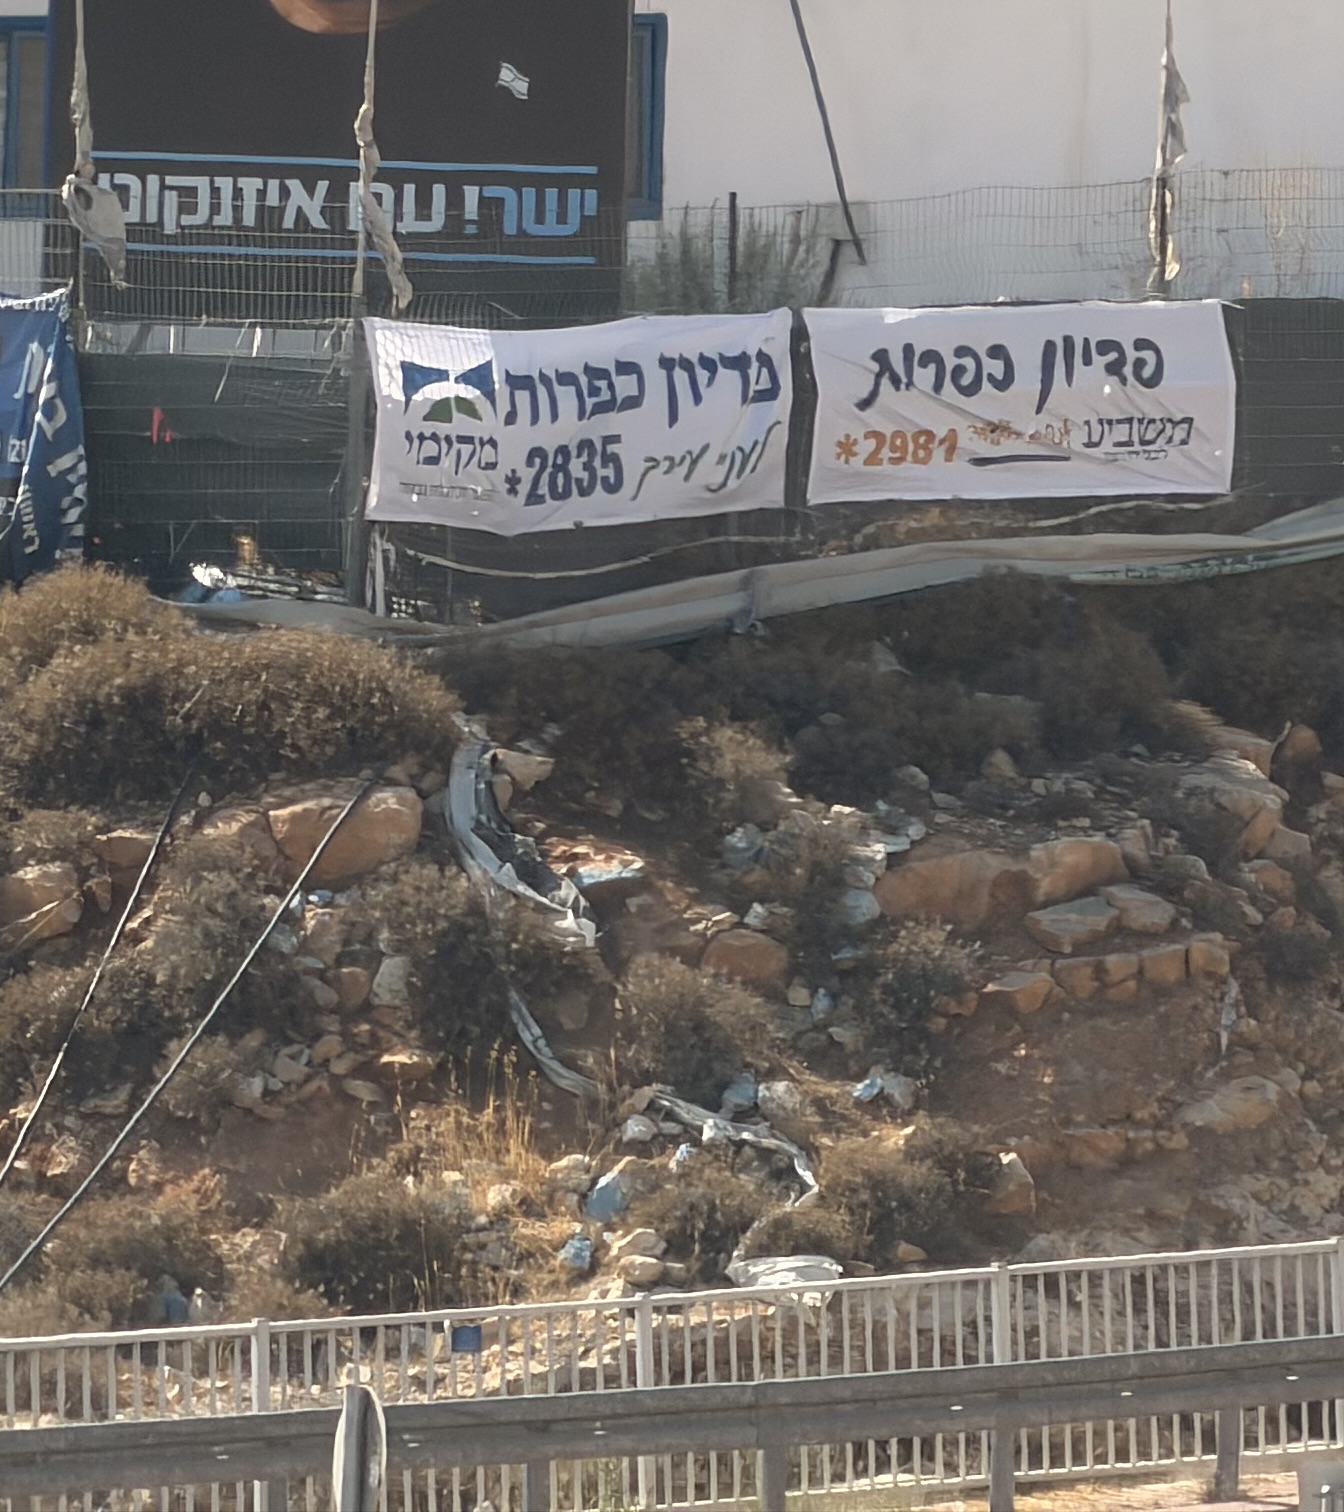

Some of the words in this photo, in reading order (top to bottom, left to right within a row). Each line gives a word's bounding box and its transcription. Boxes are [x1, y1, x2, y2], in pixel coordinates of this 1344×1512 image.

[462, 185, 597, 236] ישר!
[504, 358, 646, 427] כפרות
[658, 346, 782, 429] פדיון
[855, 342, 1015, 412] כפרות
[1035, 335, 1164, 416] פדיון
[405, 430, 499, 476] מקימי
[1082, 415, 1195, 449] משביע
